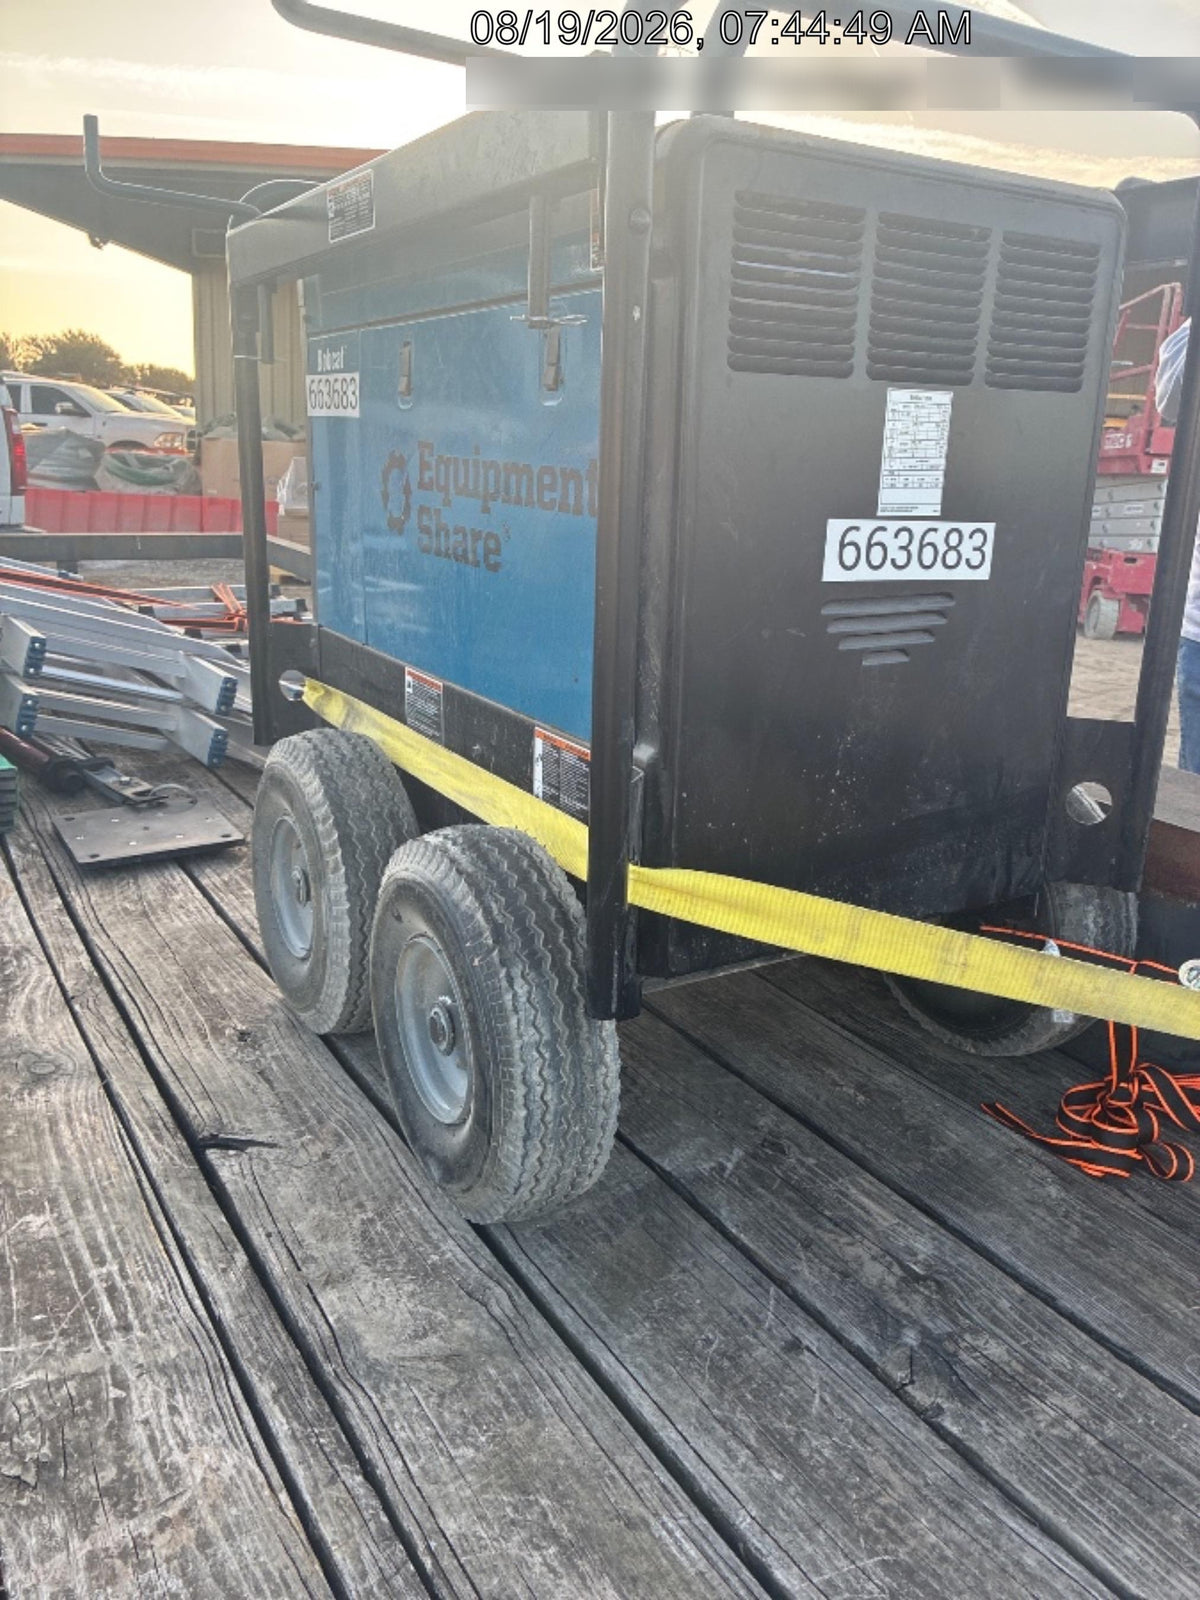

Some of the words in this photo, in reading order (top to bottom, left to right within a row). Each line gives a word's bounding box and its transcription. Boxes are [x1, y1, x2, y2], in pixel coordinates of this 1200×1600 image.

[309, 376, 358, 410] 663683
[417, 440, 598, 517] Equipment
[417, 505, 502, 572] Share
[838, 525, 988, 571] 663683
